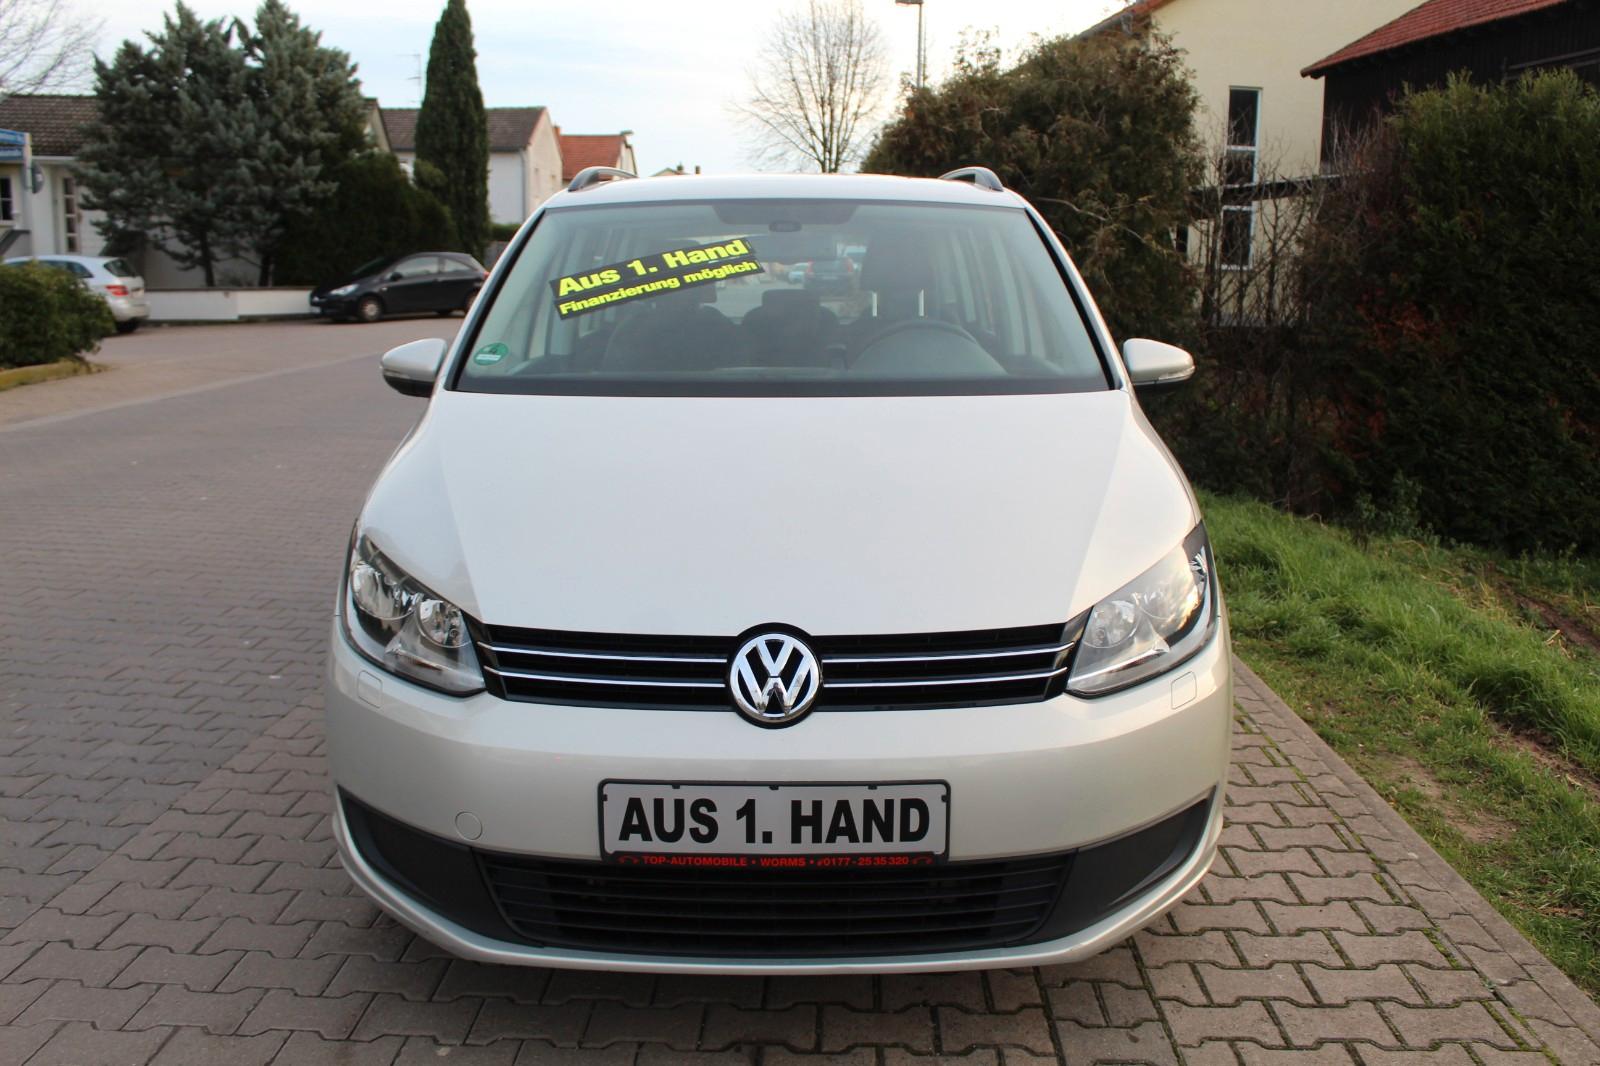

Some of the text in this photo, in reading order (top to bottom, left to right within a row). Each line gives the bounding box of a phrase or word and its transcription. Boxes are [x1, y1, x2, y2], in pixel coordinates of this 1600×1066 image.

[559, 239, 749, 296] Aus 1. Hand
[559, 261, 758, 315] Finanzierung möglich
[618, 797, 930, 844] AUS 1. HAND
[642, 855, 747, 867] TOP-AUTOMOBILE
[760, 856, 806, 867] WORMS
